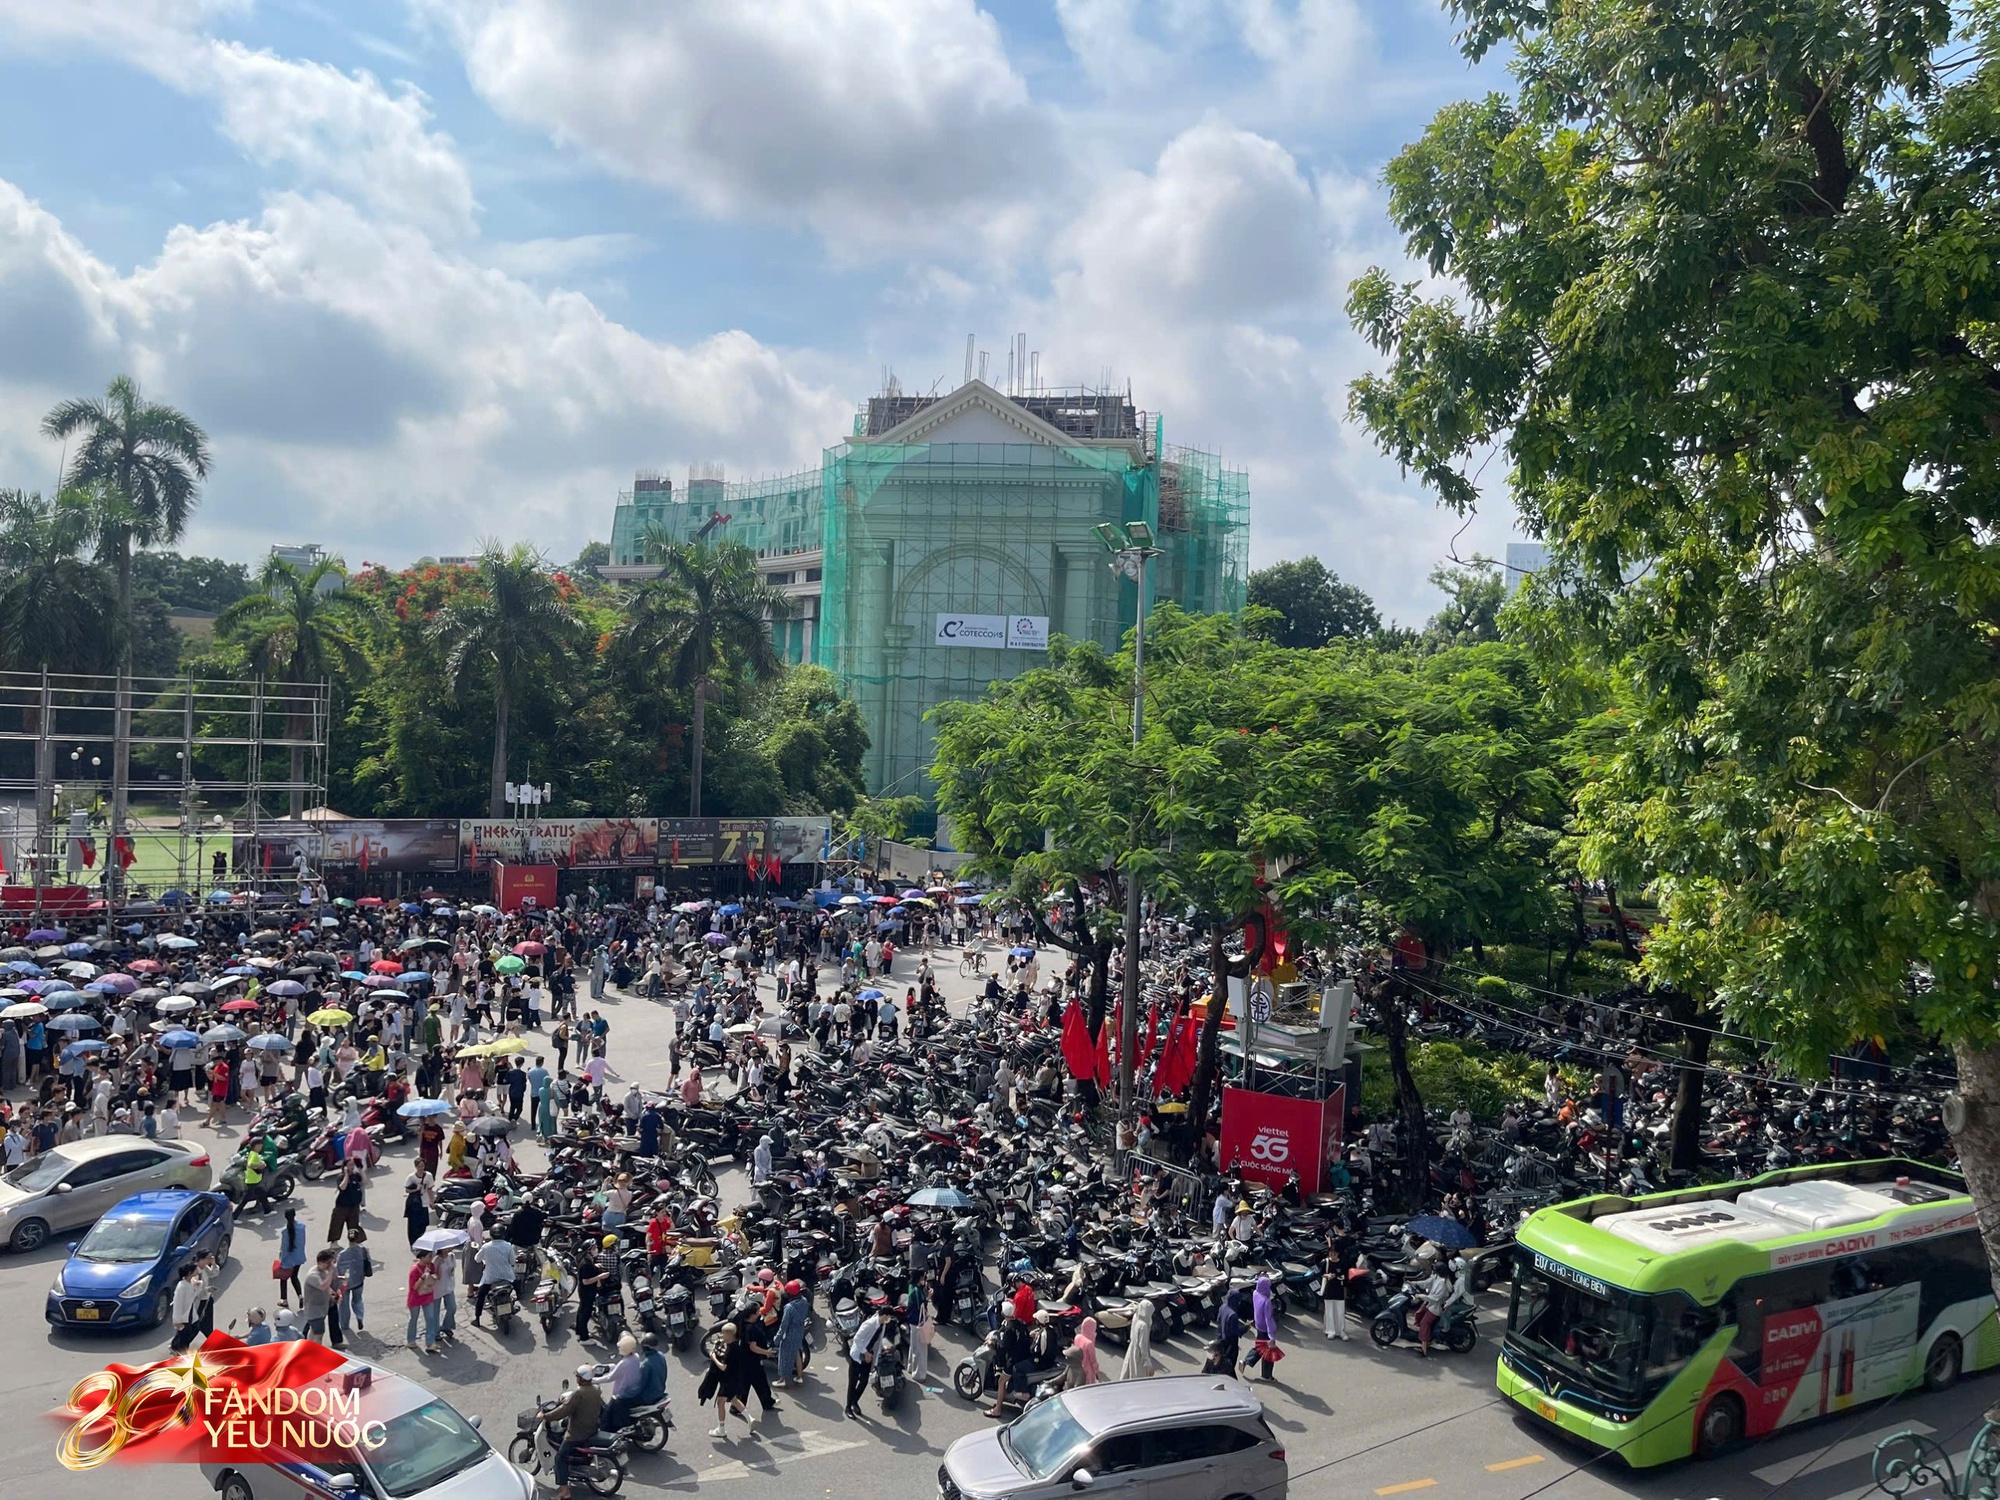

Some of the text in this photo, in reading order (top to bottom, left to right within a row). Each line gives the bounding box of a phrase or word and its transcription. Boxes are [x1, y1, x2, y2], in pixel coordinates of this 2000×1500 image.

[1258, 1126, 1289, 1138] viettel
[1250, 1134, 1289, 1163] 5G
[1825, 1234, 1876, 1257] CADIVI
[1767, 1320, 1818, 1343] CADIVI
